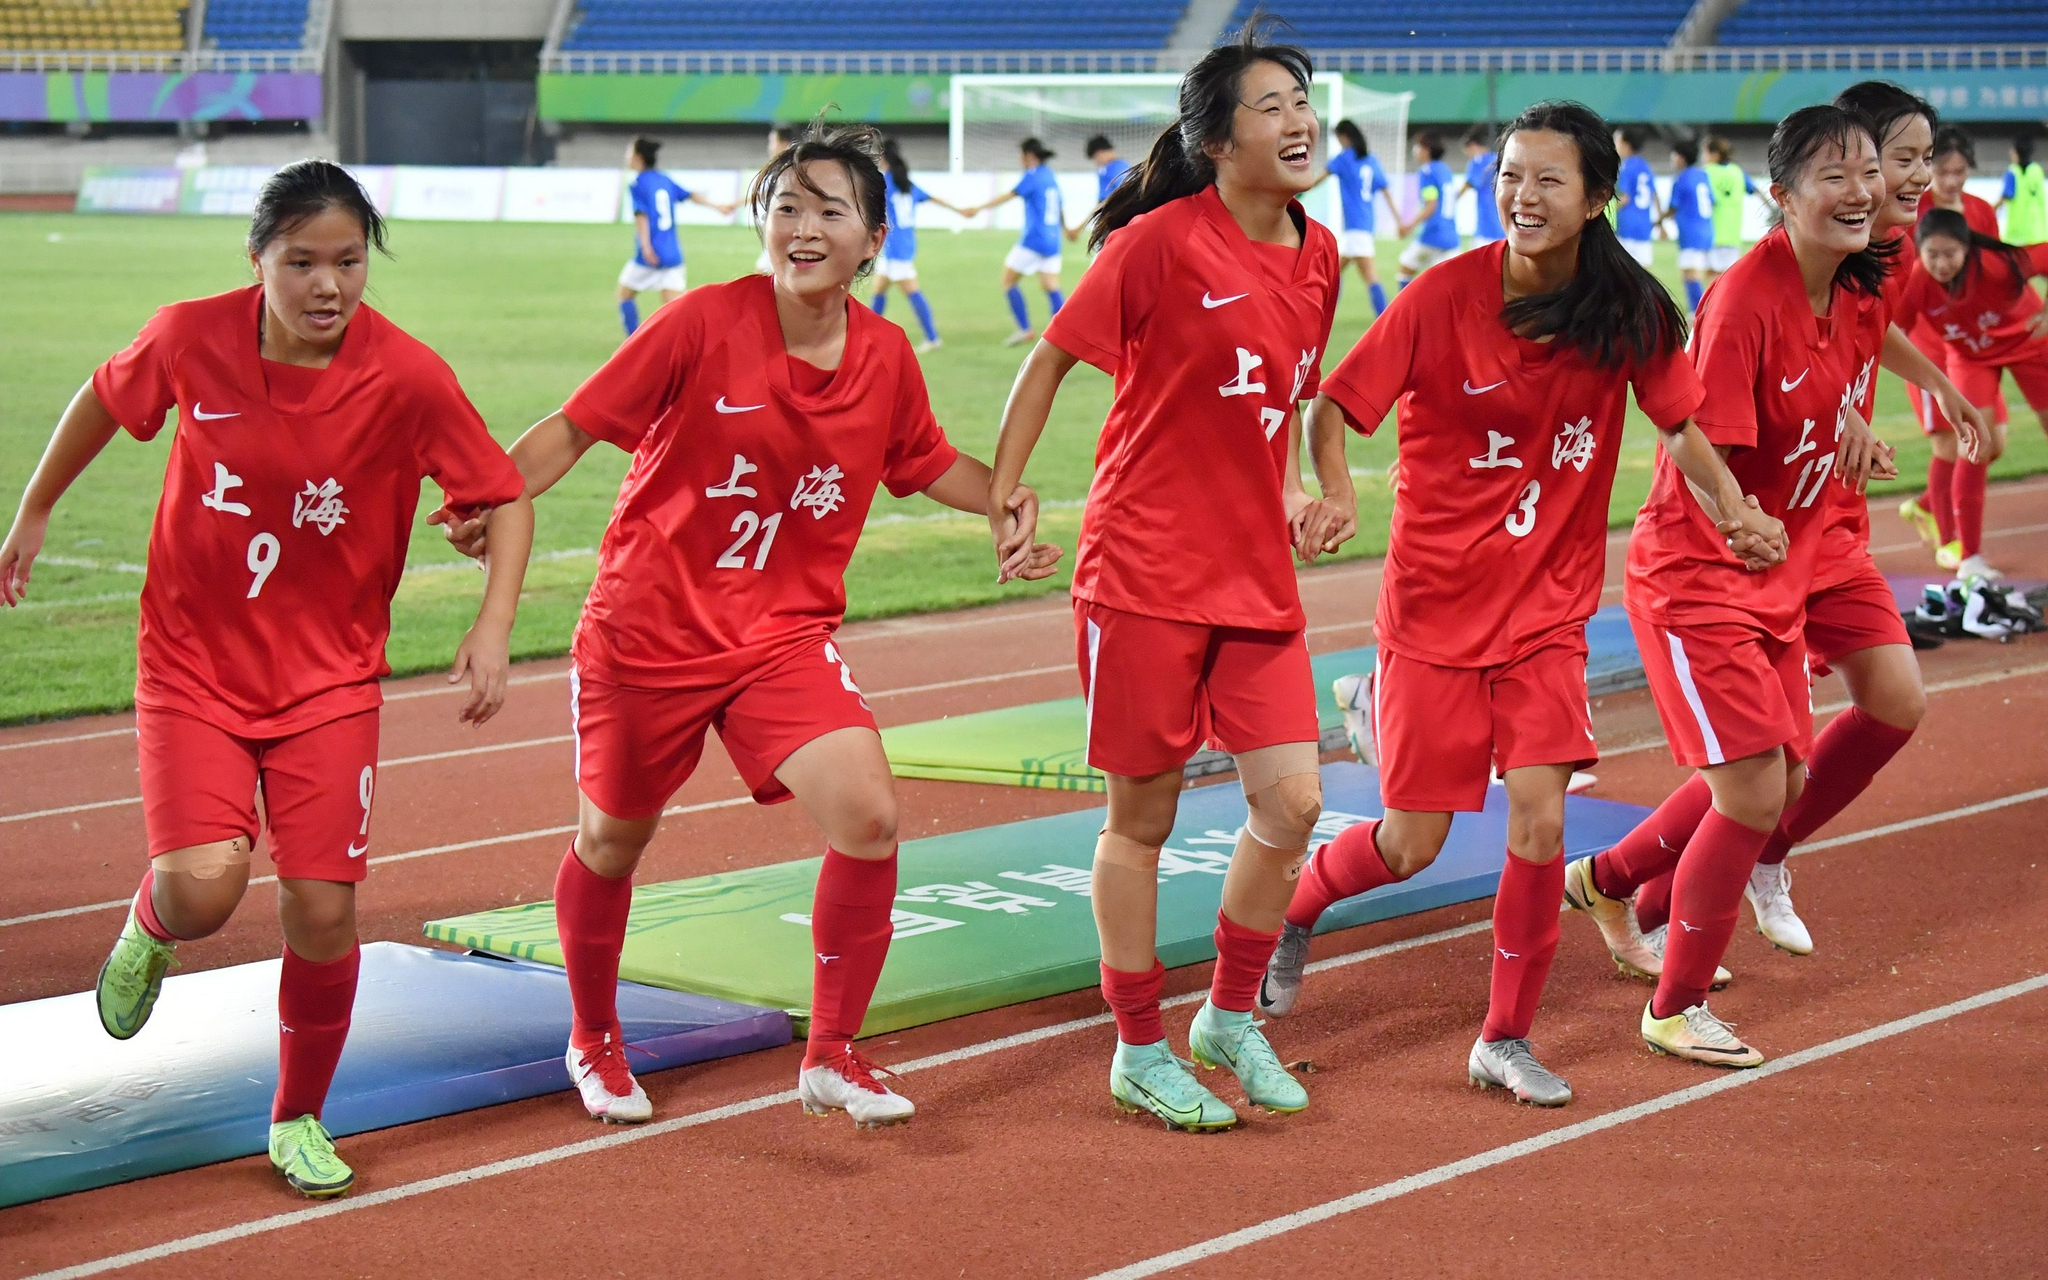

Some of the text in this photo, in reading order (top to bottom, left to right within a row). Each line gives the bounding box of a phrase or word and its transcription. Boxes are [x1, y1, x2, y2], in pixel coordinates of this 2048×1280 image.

[655, 189, 673, 231] 9
[1260, 406, 1286, 443] 7
[1468, 415, 1597, 473] 上海
[201, 461, 350, 537] 上海
[705, 453, 846, 520] 上海
[1504, 479, 1541, 538] 3
[1786, 451, 1836, 511] 17
[246, 532, 281, 599] 9
[715, 510, 783, 571] 21
[359, 765, 373, 835] 9
